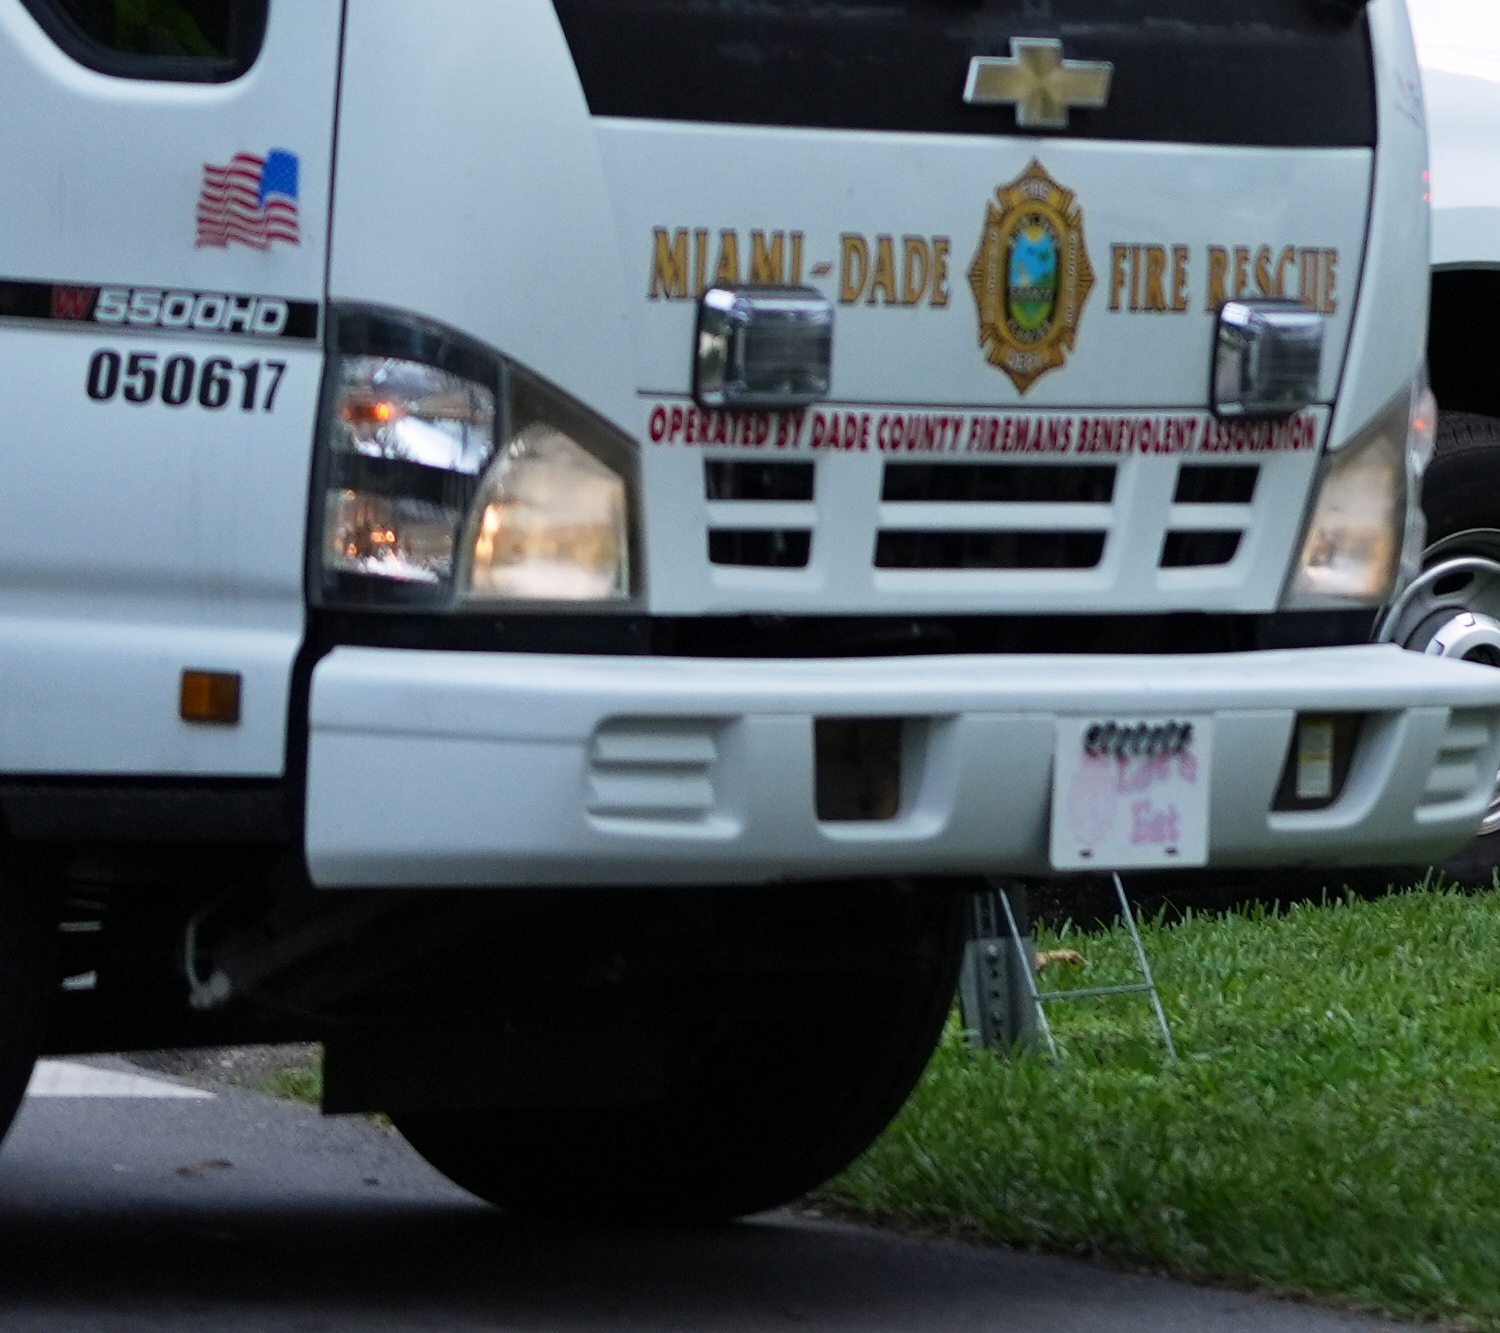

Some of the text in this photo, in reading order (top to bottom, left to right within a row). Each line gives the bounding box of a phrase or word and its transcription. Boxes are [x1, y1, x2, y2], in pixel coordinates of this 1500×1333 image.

[647, 225, 952, 307] MIAMI-DADE
[1108, 243, 1189, 313] FIRE
[1204, 243, 1337, 314] RESCUE
[85, 348, 288, 412] 050617
[651, 404, 772, 446] OPERATED
[774, 409, 806, 448] BY
[809, 412, 871, 451] DADE
[876, 414, 965, 452] COUNTY
[1076, 417, 1197, 454] BENEVOLENT
[1200, 415, 1317, 451] ASSOCIATION
